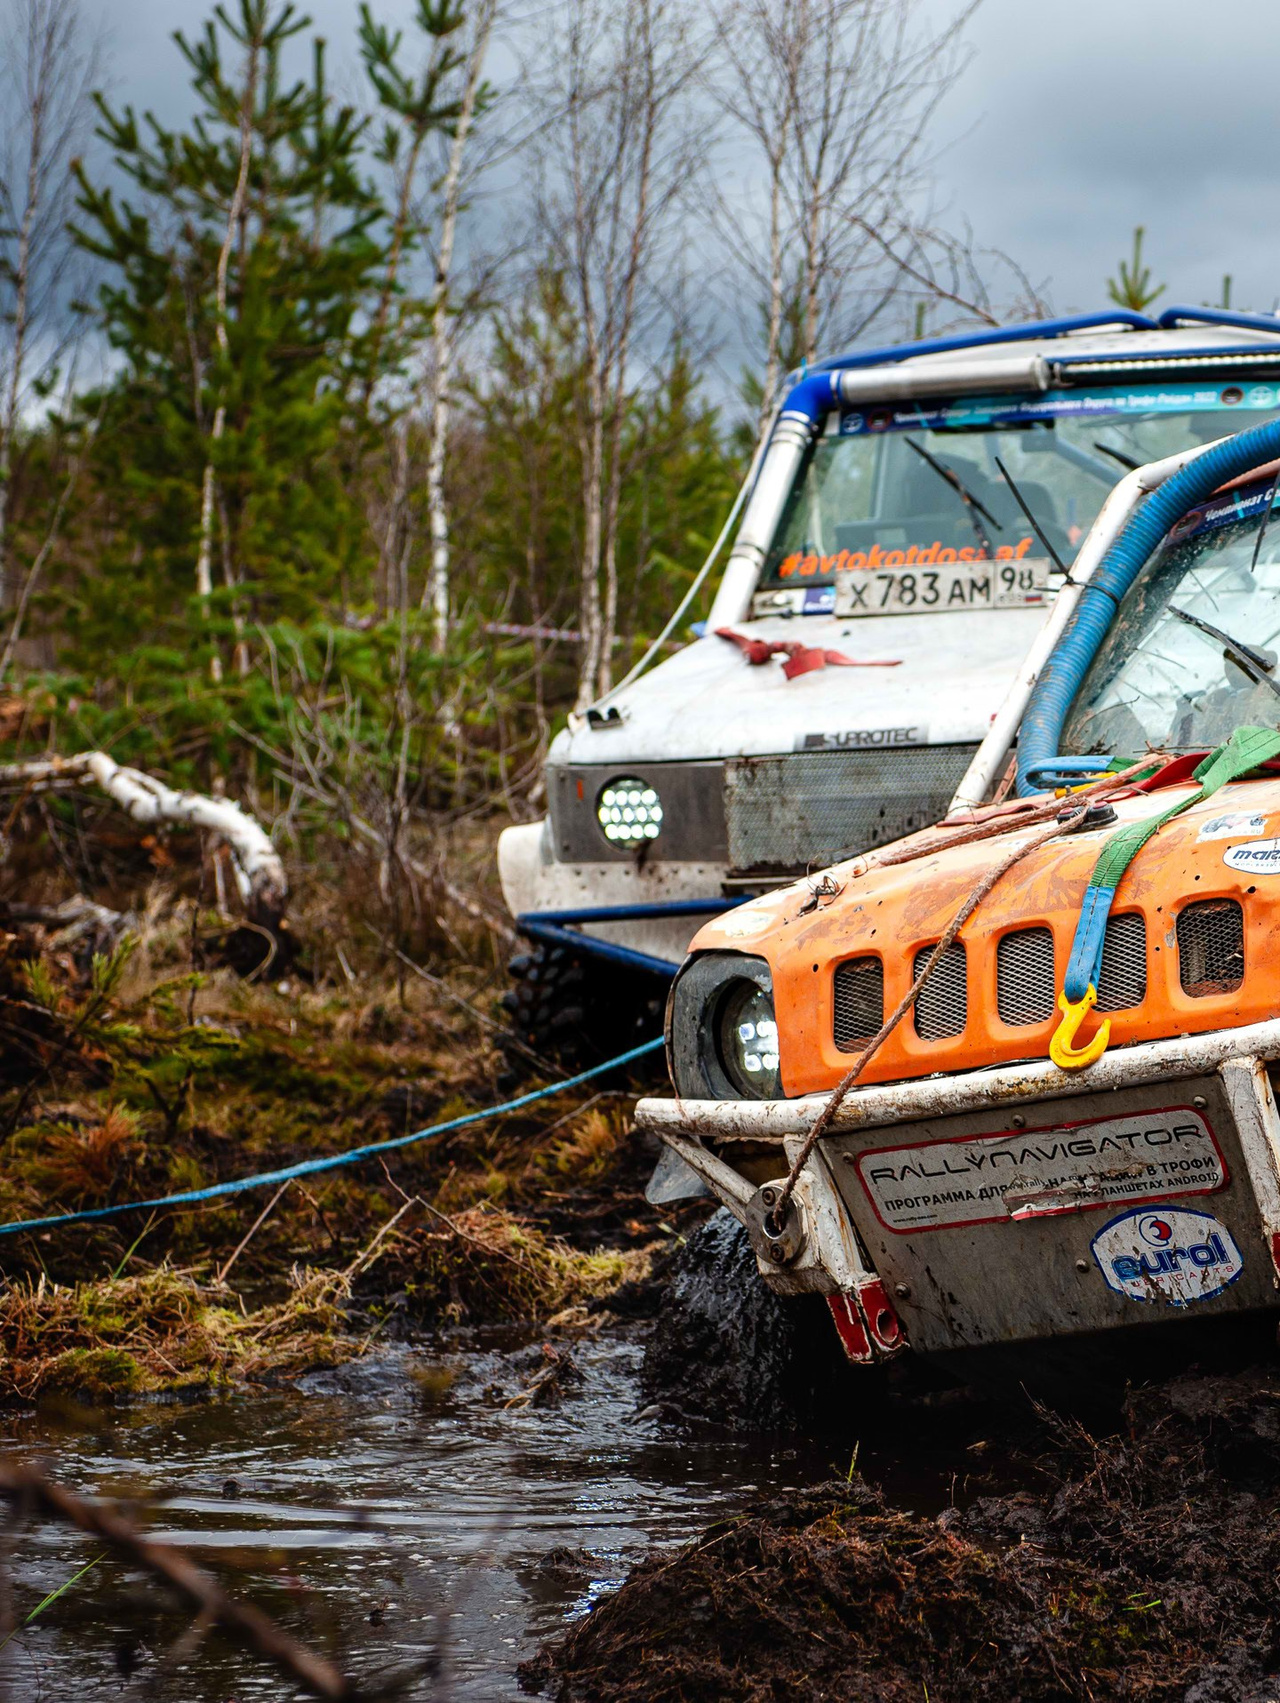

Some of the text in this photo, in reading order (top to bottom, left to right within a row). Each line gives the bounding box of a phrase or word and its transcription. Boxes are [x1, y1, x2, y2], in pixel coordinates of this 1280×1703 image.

[779, 537, 1033, 578] #avtokotdosaf
[885, 1189, 975, 1211] ПРОГРАММА
[978, 1184, 1008, 1201] ДЛЯ
[1159, 1156, 1215, 1174] ТРОФИ
[1167, 1171, 1219, 1187] ANDROID
[1111, 1232, 1231, 1280] eurol
